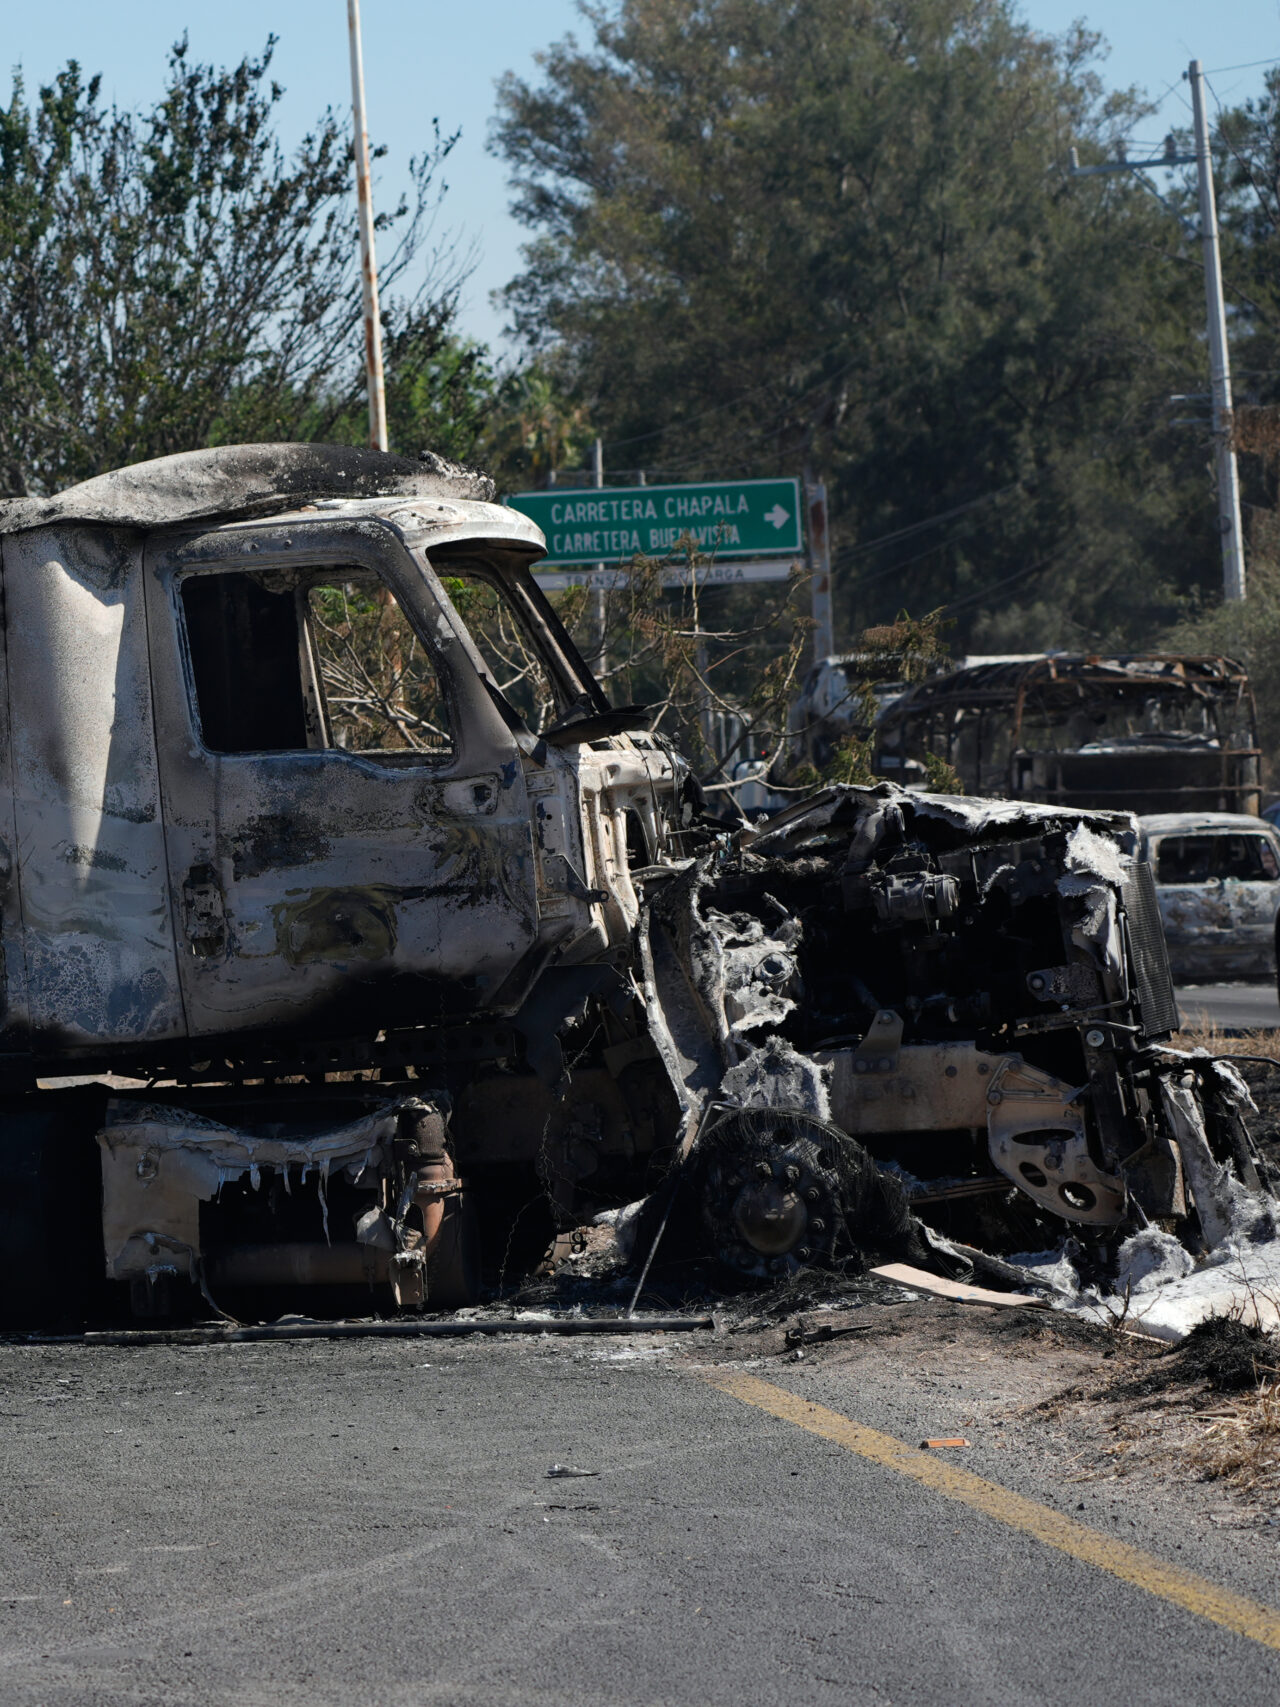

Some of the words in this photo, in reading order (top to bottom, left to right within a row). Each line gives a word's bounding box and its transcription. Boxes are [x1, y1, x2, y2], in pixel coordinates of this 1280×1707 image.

[551, 499, 658, 524] CARRETERA
[664, 493, 749, 518] CHAPALA
[553, 529, 641, 553] CARRETERA
